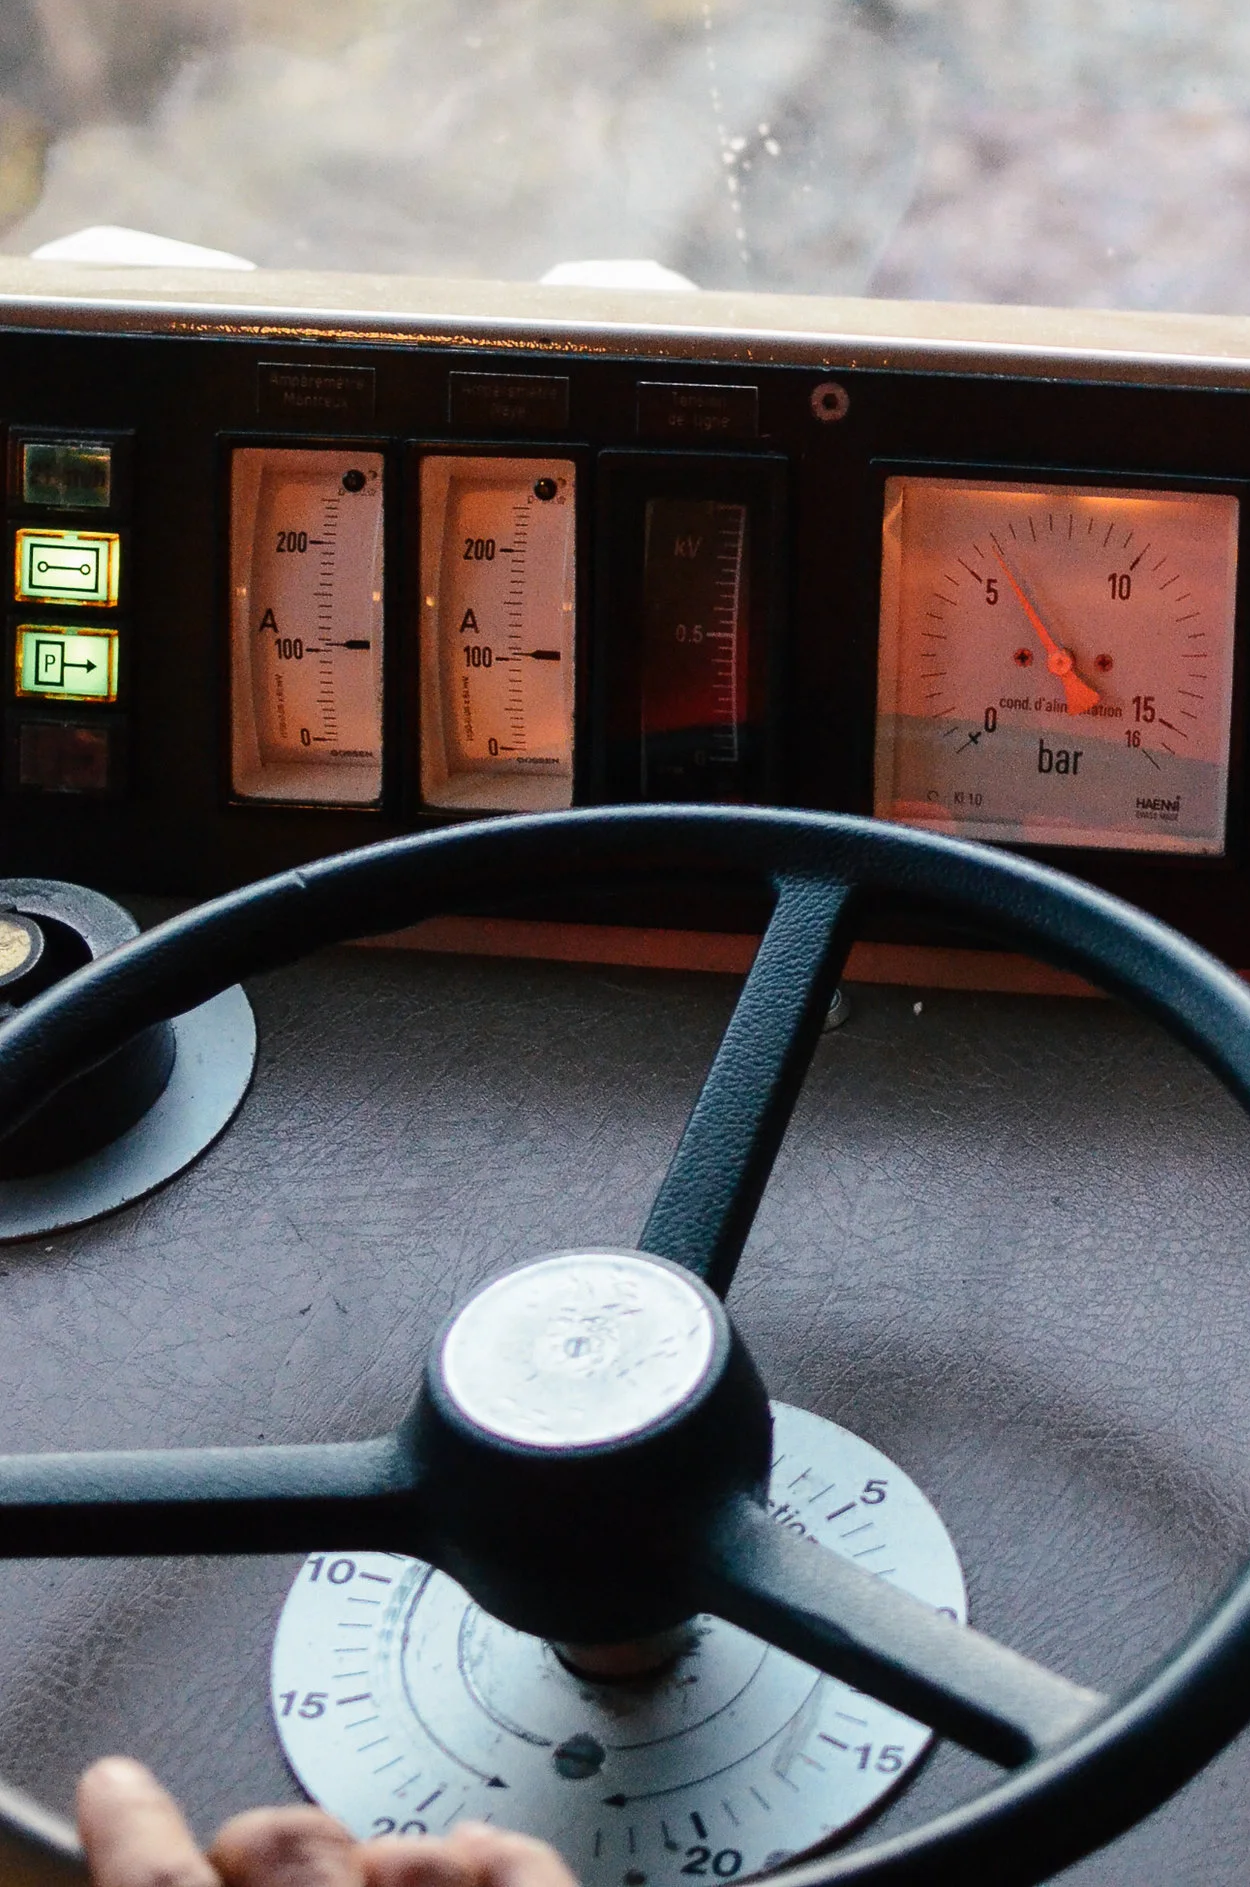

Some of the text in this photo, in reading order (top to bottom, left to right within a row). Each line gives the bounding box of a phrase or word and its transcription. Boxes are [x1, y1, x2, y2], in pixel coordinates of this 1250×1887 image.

[276, 531, 308, 553] 200
[463, 538, 496, 560] 200
[673, 535, 704, 560] kV
[985, 578, 999, 606] 5
[1107, 572, 1132, 601] 10
[258, 608, 279, 634] A
[459, 608, 480, 634] A
[675, 623, 704, 644] 0.5
[274, 638, 304, 660] 100
[463, 645, 493, 668] 100
[998, 696, 1033, 711] cond.
[1131, 695, 1156, 722] 15
[984, 706, 998, 733] 0
[300, 727, 311, 747] 0
[488, 737, 498, 756] 0
[1124, 730, 1142, 749] 16
[1037, 737, 1084, 776] bar
[860, 1479, 889, 1505] 5
[305, 1555, 357, 1585] 10
[278, 1689, 329, 1719] 15
[852, 1742, 906, 1774] 15
[680, 1845, 744, 1878] 20
